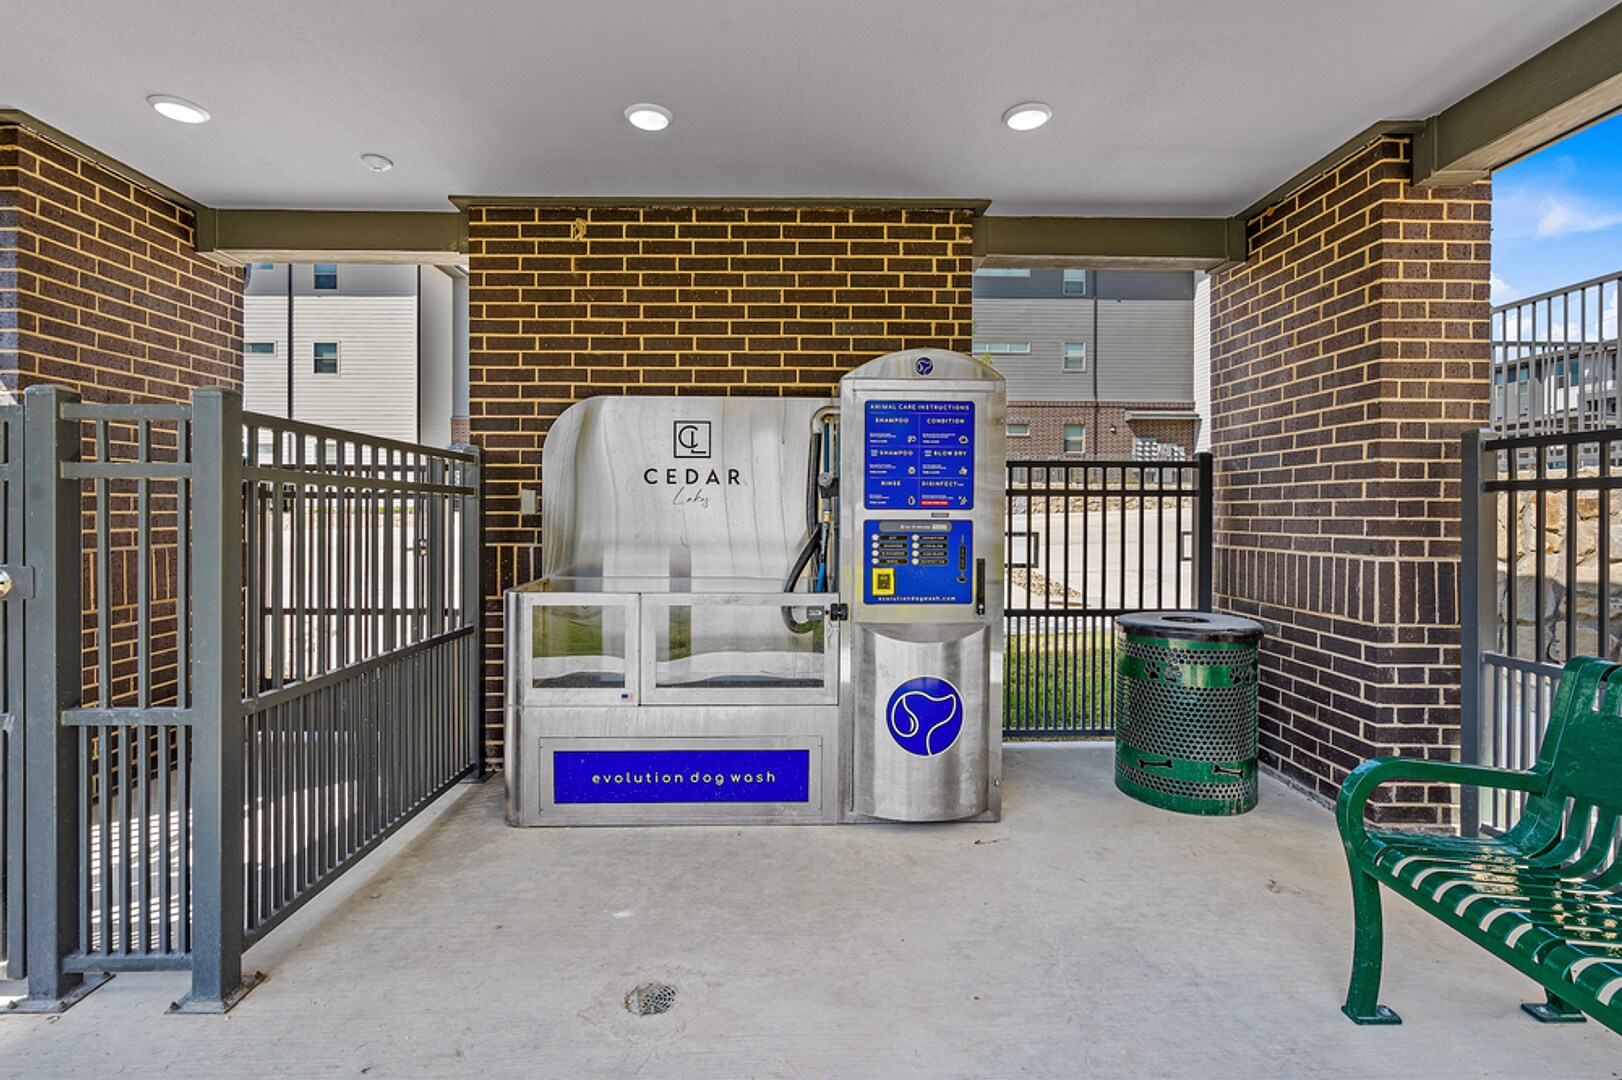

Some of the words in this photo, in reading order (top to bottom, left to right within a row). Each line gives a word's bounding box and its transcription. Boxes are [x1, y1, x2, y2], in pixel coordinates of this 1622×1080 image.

[643, 468, 740, 485] CEDAR
[591, 772, 684, 784] evolution
[690, 771, 724, 786] dog
[730, 771, 776, 784] wash
